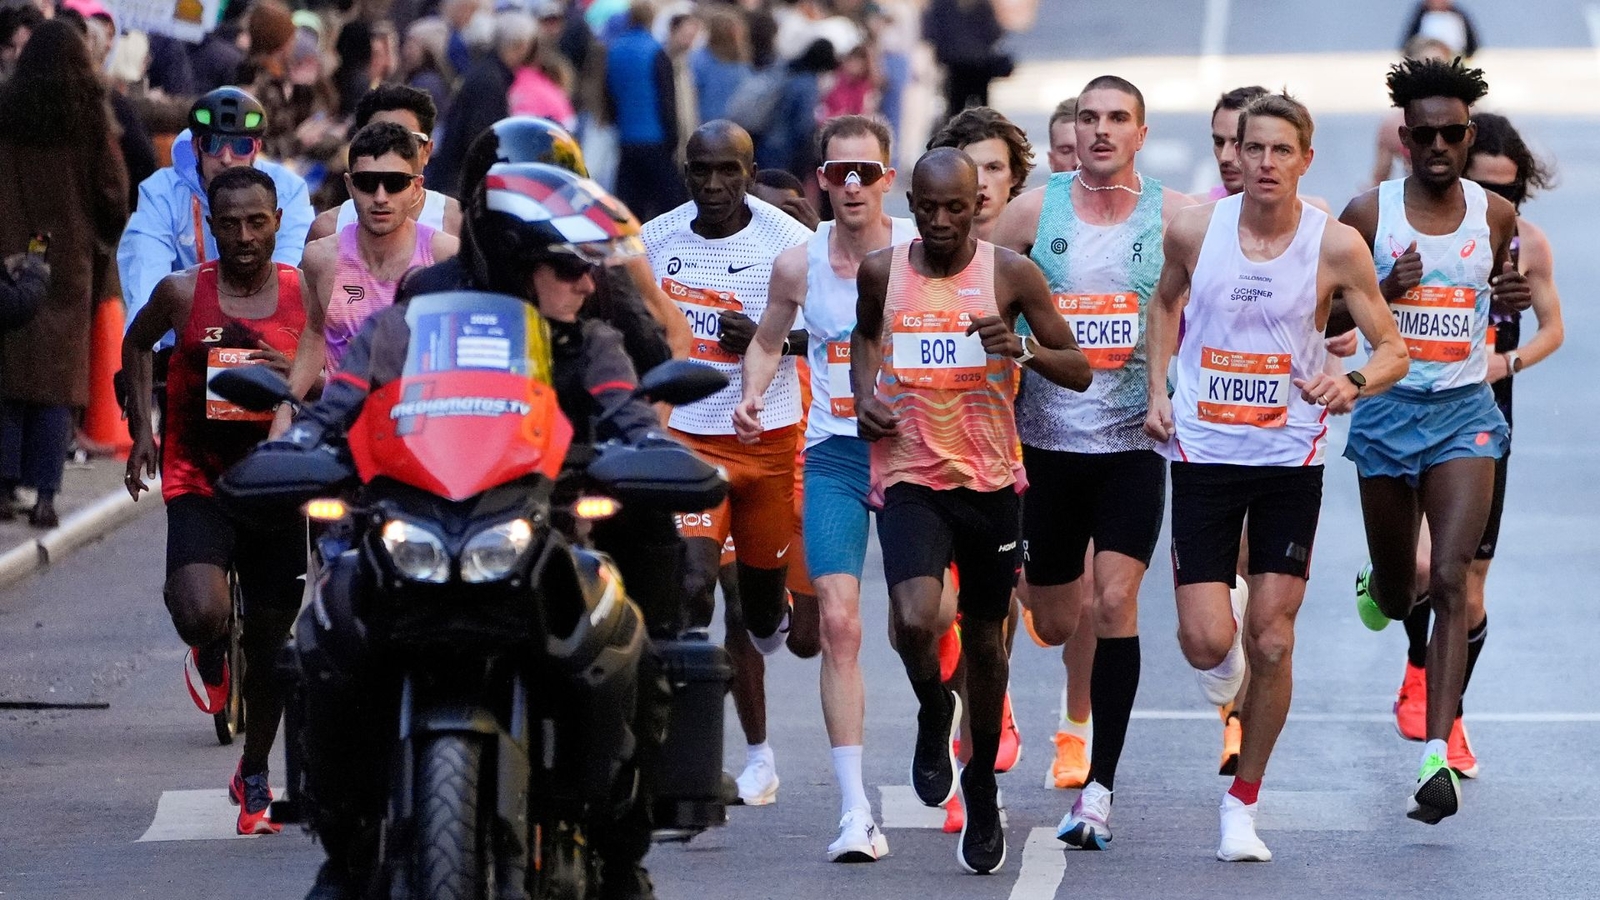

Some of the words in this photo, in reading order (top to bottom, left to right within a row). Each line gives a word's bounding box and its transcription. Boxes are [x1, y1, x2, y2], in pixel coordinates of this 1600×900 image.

[1238, 274, 1272, 283] SALOMON
[958, 287, 981, 297] HOKA
[1230, 293, 1258, 302] SPORT
[1234, 287, 1273, 299] OCHSNER
[1402, 289, 1420, 301] cs
[1058, 296, 1078, 309] tcs
[903, 314, 922, 327] tcs
[1067, 320, 1132, 345] ECKER
[219, 350, 237, 364] tcs
[920, 338, 957, 365] BOR
[1211, 351, 1230, 365] tcs
[954, 373, 981, 383] 2025
[1208, 375, 1279, 404] KYBURZ
